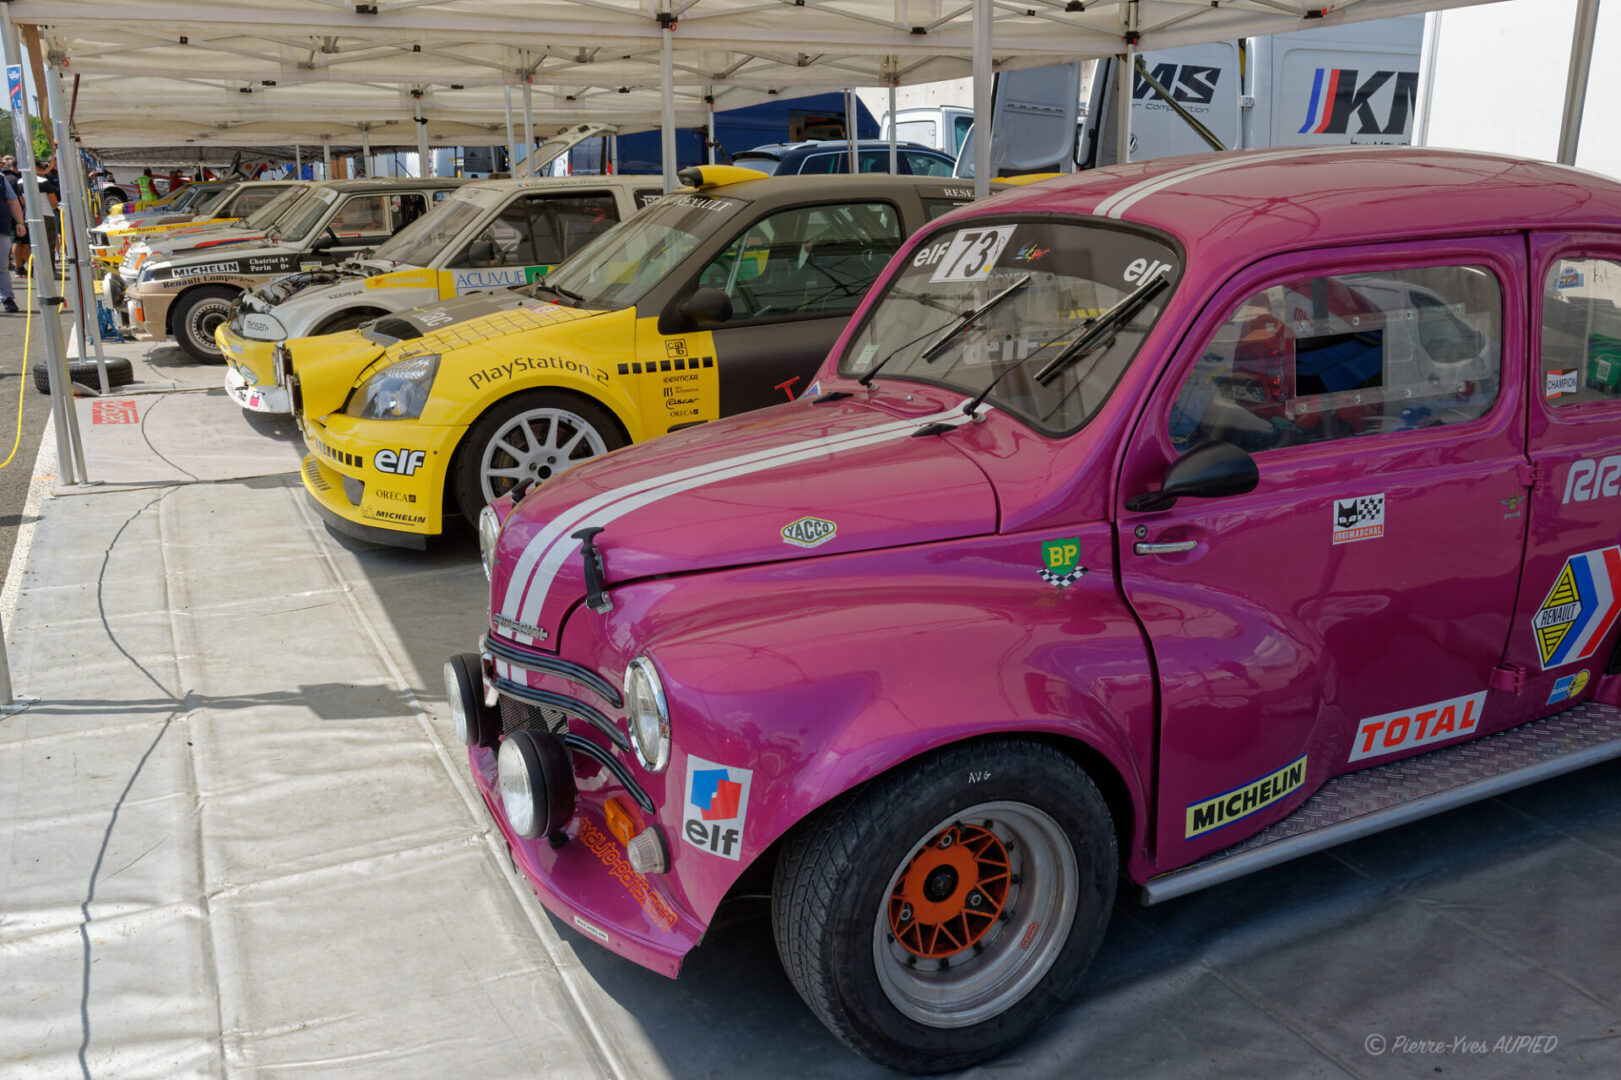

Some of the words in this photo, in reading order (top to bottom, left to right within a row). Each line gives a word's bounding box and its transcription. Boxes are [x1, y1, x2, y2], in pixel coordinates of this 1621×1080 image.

[913, 241, 950, 267] elf
[944, 230, 998, 278] 73
[173, 262, 238, 277] MICHELIN
[456, 270, 525, 287] ACUVUE
[163, 277, 201, 289] Renault
[469, 356, 590, 390] PlayStation
[1548, 376, 1577, 392] CHAMPION
[373, 448, 426, 476] elf
[376, 489, 408, 503] ORECA
[376, 510, 426, 523] MICHELIN
[787, 520, 830, 540] YACCO
[1349, 525, 1383, 538] MARCHAL
[1047, 544, 1078, 568] BP
[1541, 603, 1577, 626] RENAULT
[1360, 700, 1476, 753] TOTAL
[1192, 762, 1303, 832] MICHELIN
[685, 819, 739, 856] elf
